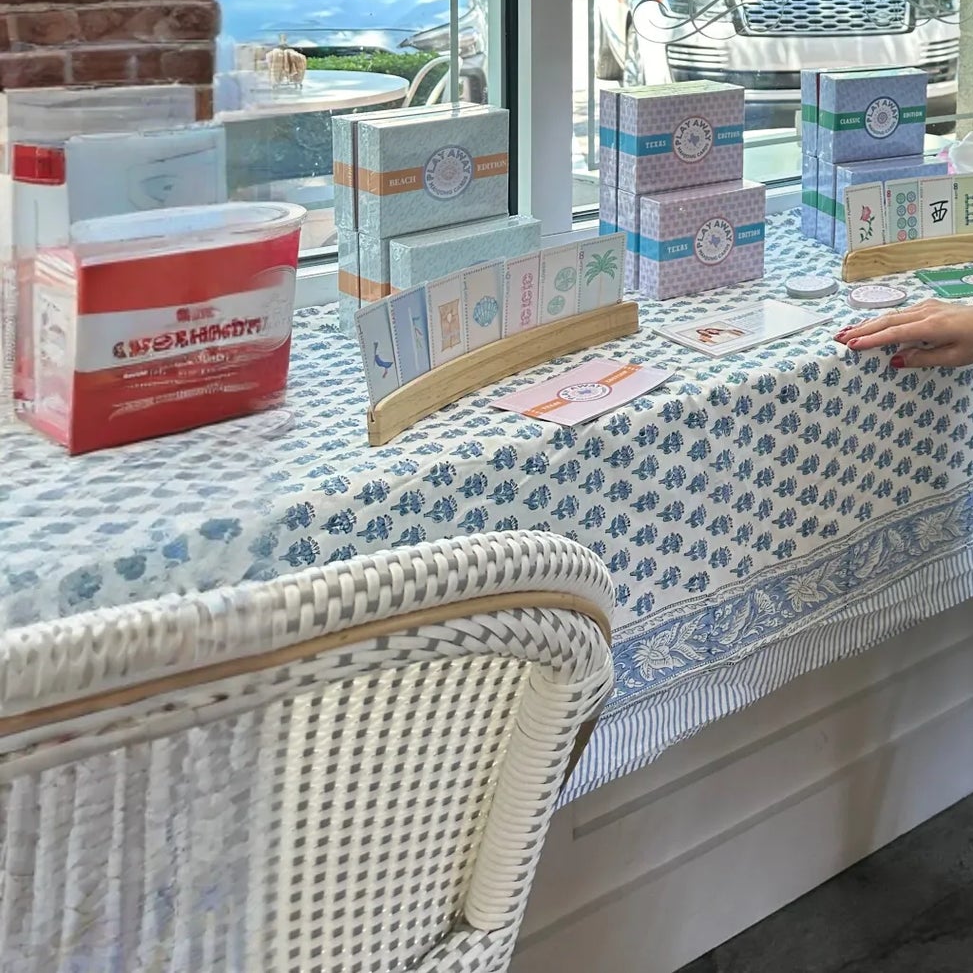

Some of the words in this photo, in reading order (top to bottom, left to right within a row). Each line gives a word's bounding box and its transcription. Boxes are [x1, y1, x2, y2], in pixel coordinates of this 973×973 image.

[866, 101, 881, 123] PLAY
[881, 99, 898, 120] AWAY
[902, 111, 923, 119] EDITION
[840, 117, 861, 125] CLASSIC
[675, 120, 691, 146] PLAY
[692, 119, 712, 142] AWAY
[717, 130, 741, 140] EDITION
[645, 139, 667, 149] TEXAS
[426, 150, 446, 181] PLAY
[447, 149, 471, 174] AWAY
[477, 158, 508, 173] EDITION
[389, 175, 417, 187] BEACH
[696, 222, 712, 248] PLAY
[713, 220, 733, 242] AWAY
[738, 229, 761, 239] EDITION
[667, 243, 688, 254] TEXAS
